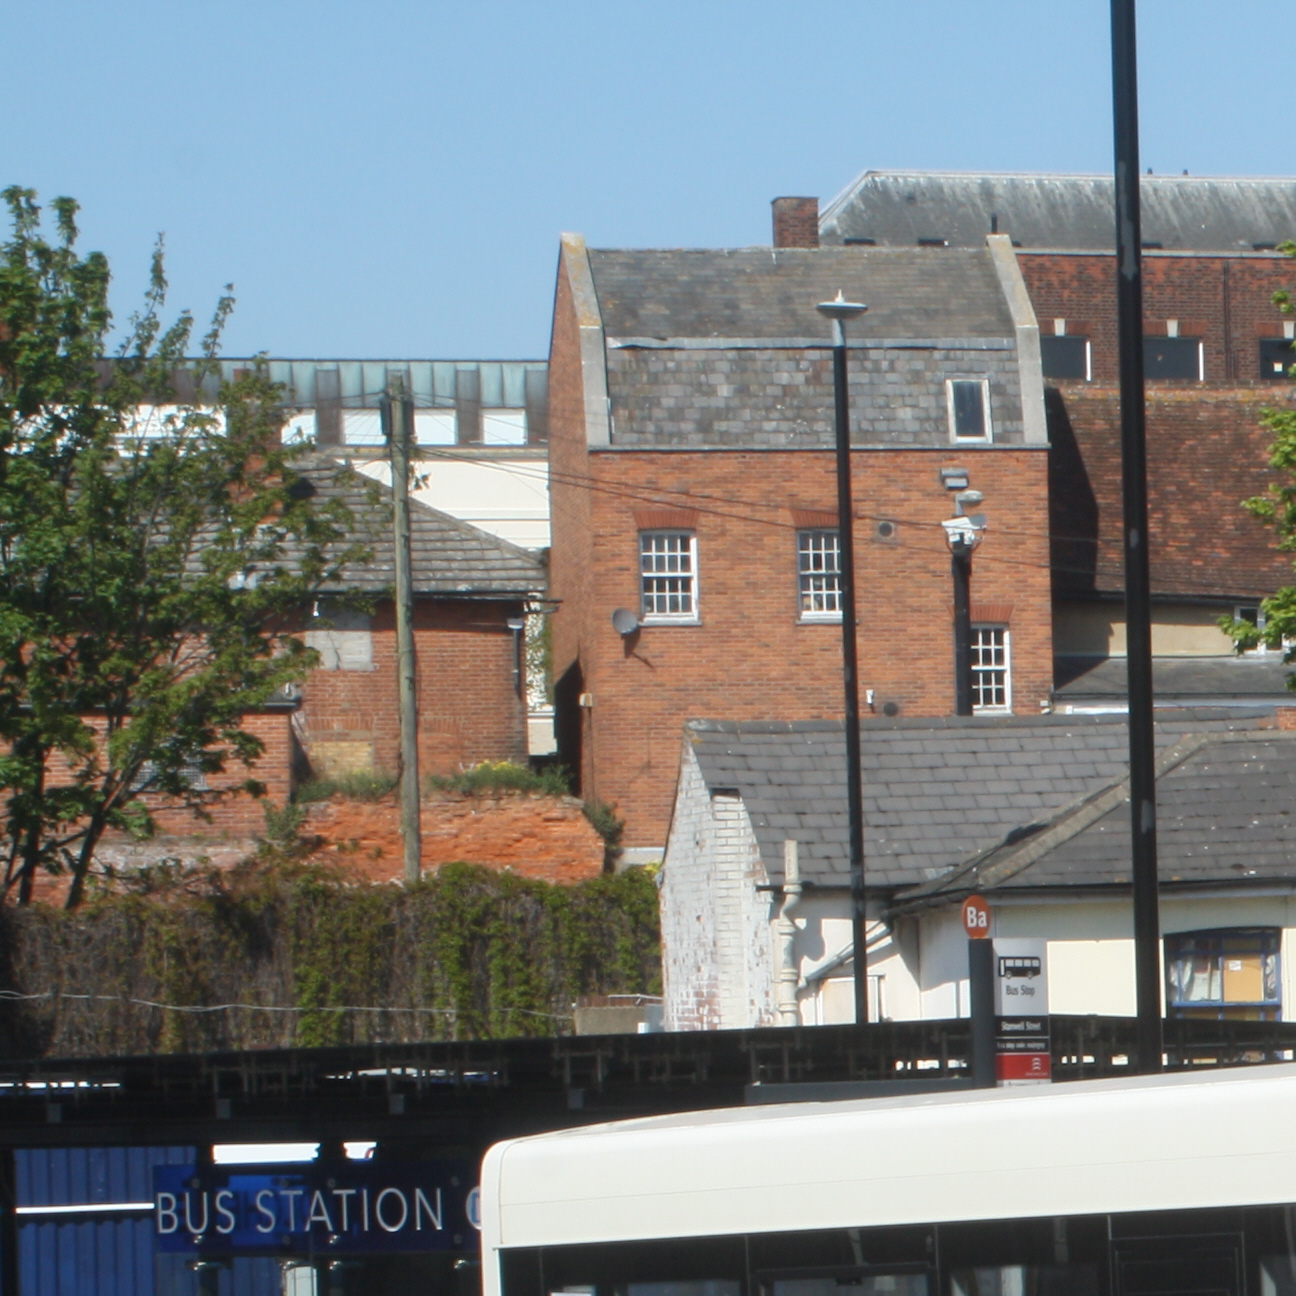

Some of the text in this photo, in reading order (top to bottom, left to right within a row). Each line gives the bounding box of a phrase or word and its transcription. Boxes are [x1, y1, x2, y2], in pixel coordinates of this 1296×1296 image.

[966, 907, 988, 928] Ba
[1006, 985, 1036, 997] Bus Stop
[157, 1187, 443, 1234] BUS STATION
